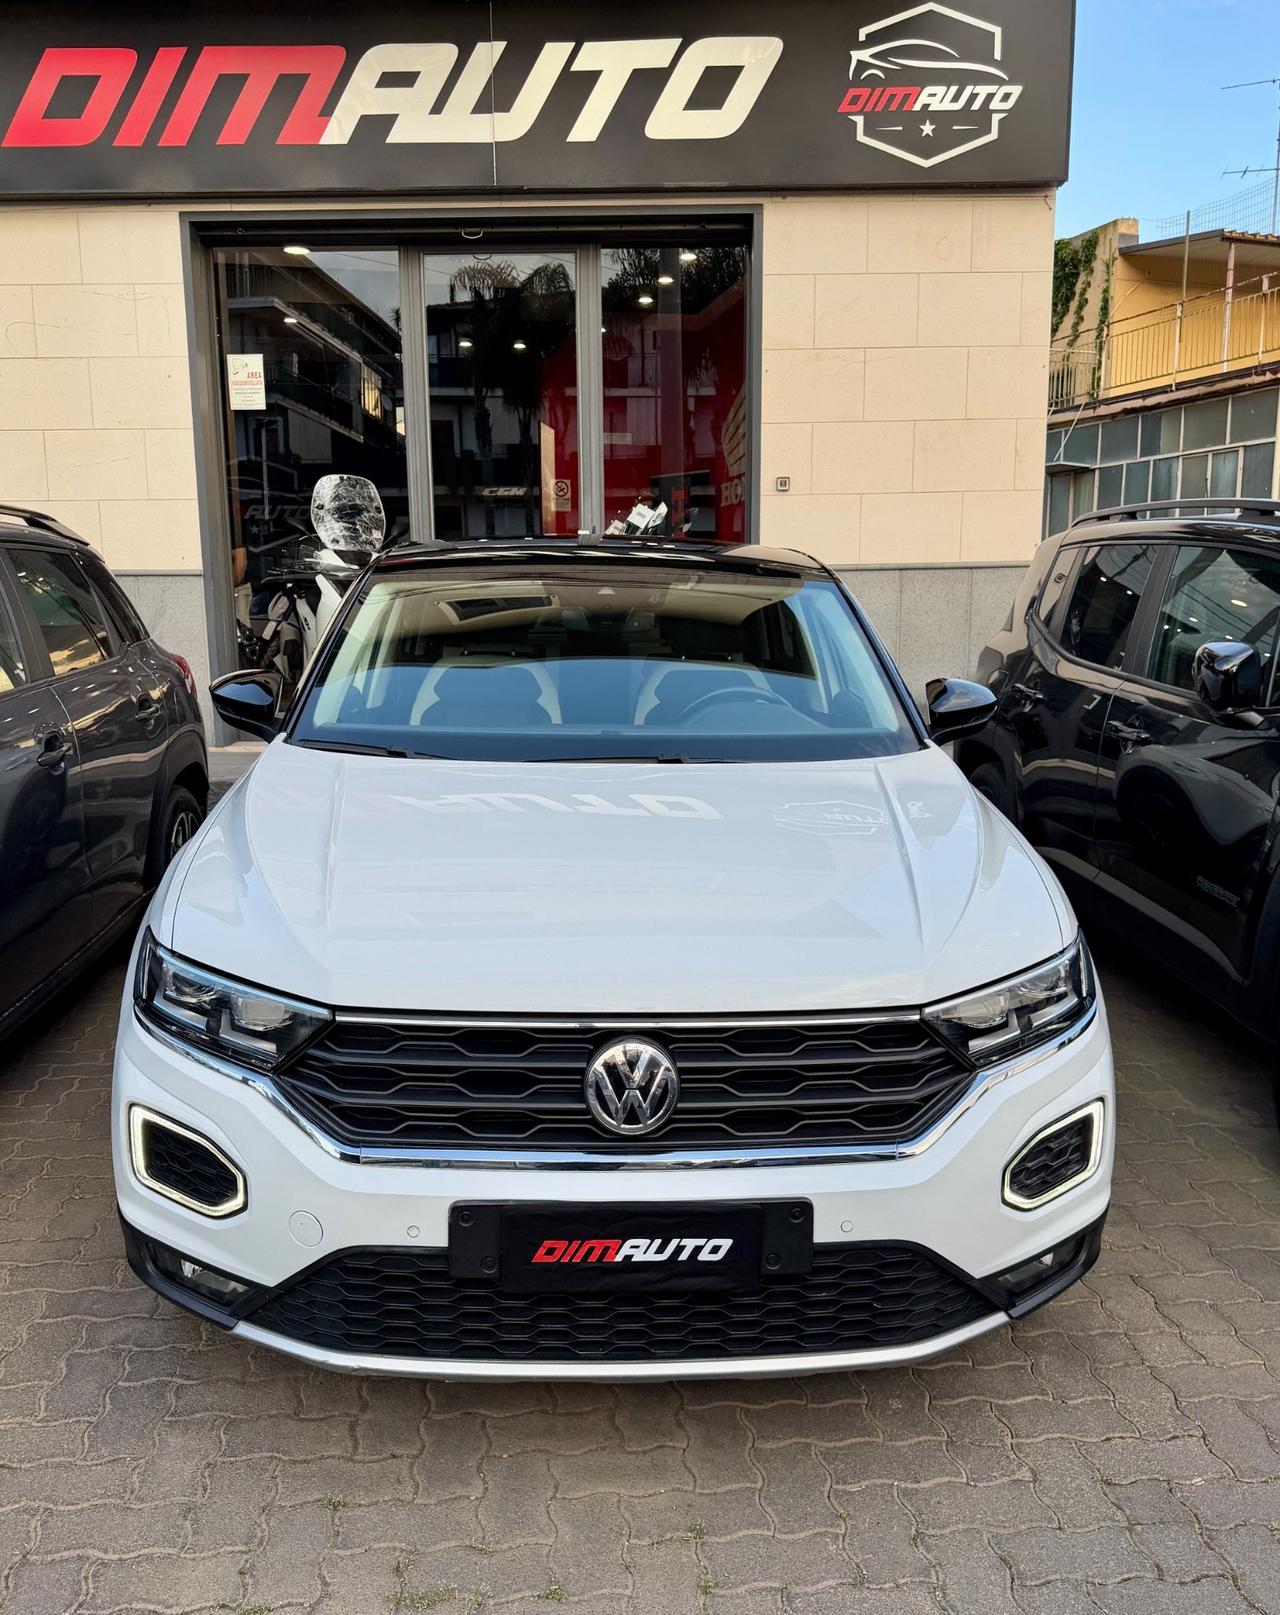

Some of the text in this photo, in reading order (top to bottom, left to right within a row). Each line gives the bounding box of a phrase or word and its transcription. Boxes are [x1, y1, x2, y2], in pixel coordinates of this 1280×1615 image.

[1, 36, 784, 147] DIMAUTO
[837, 85, 1023, 113] DIMAUTO
[246, 371, 262, 379] AREA
[531, 1237, 733, 1264] DIMAUTO
